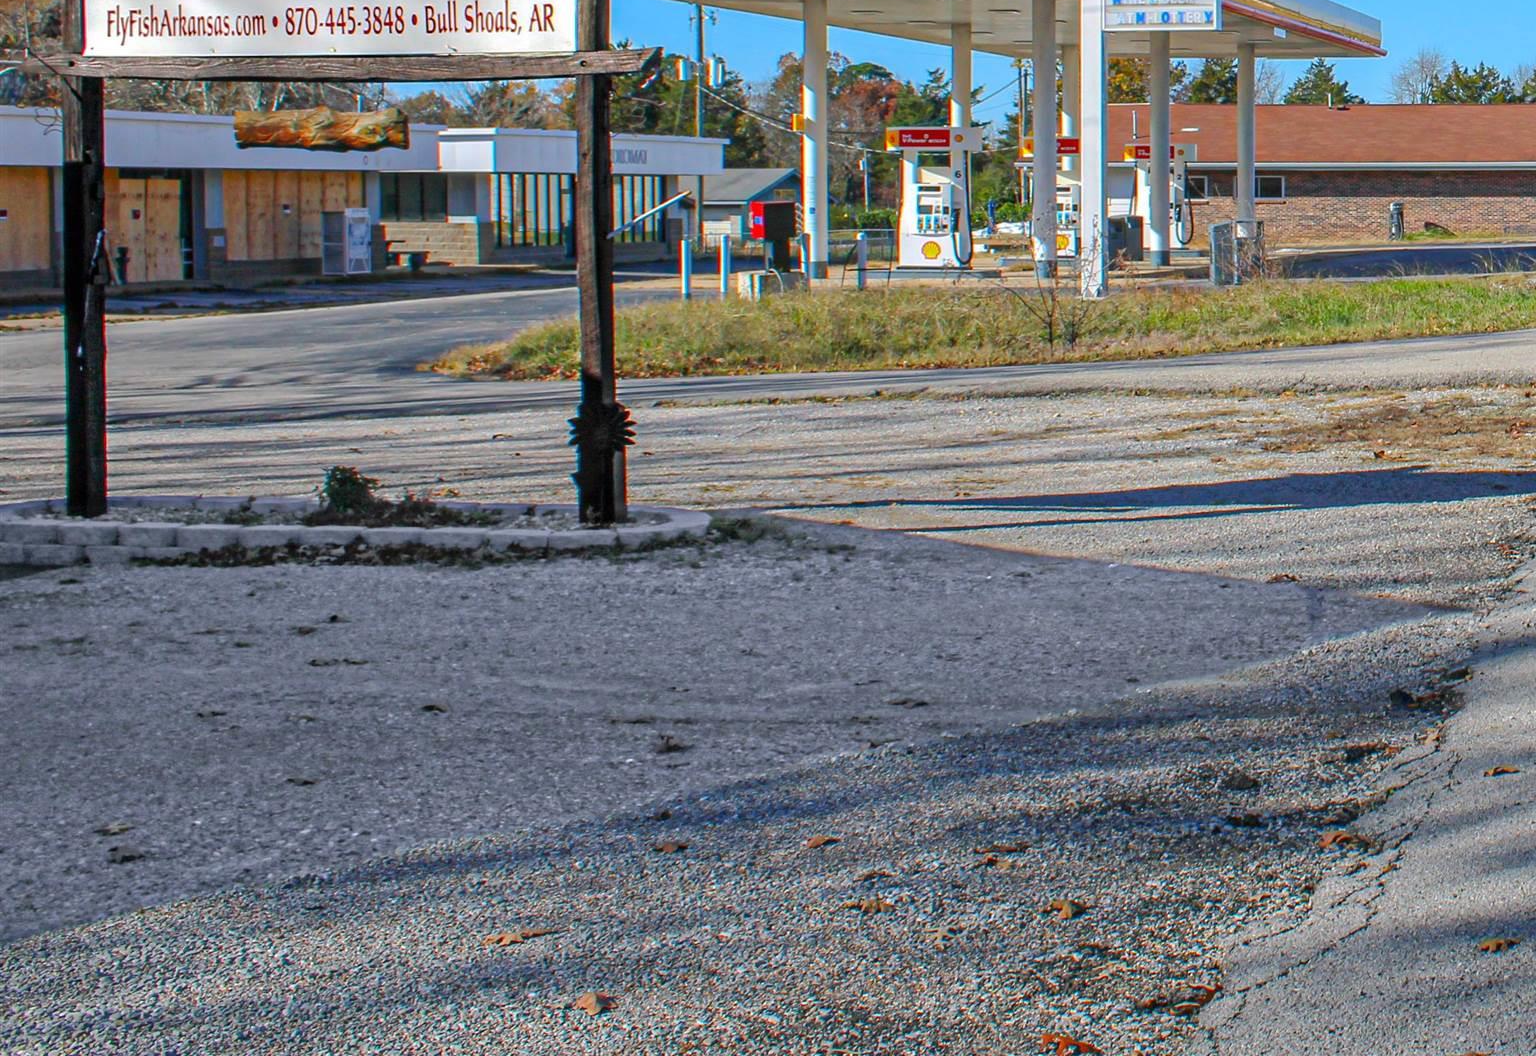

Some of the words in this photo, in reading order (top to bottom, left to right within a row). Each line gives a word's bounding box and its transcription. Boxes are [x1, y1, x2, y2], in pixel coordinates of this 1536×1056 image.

[107, 4, 267, 46] FlyFishArkansas.com
[285, 6, 406, 35] 870-445-3848
[424, 0, 459, 34] Bull
[464, 0, 522, 35] Shoals,
[529, 3, 555, 33] AR
[1153, 10, 1214, 24] LOTTERY
